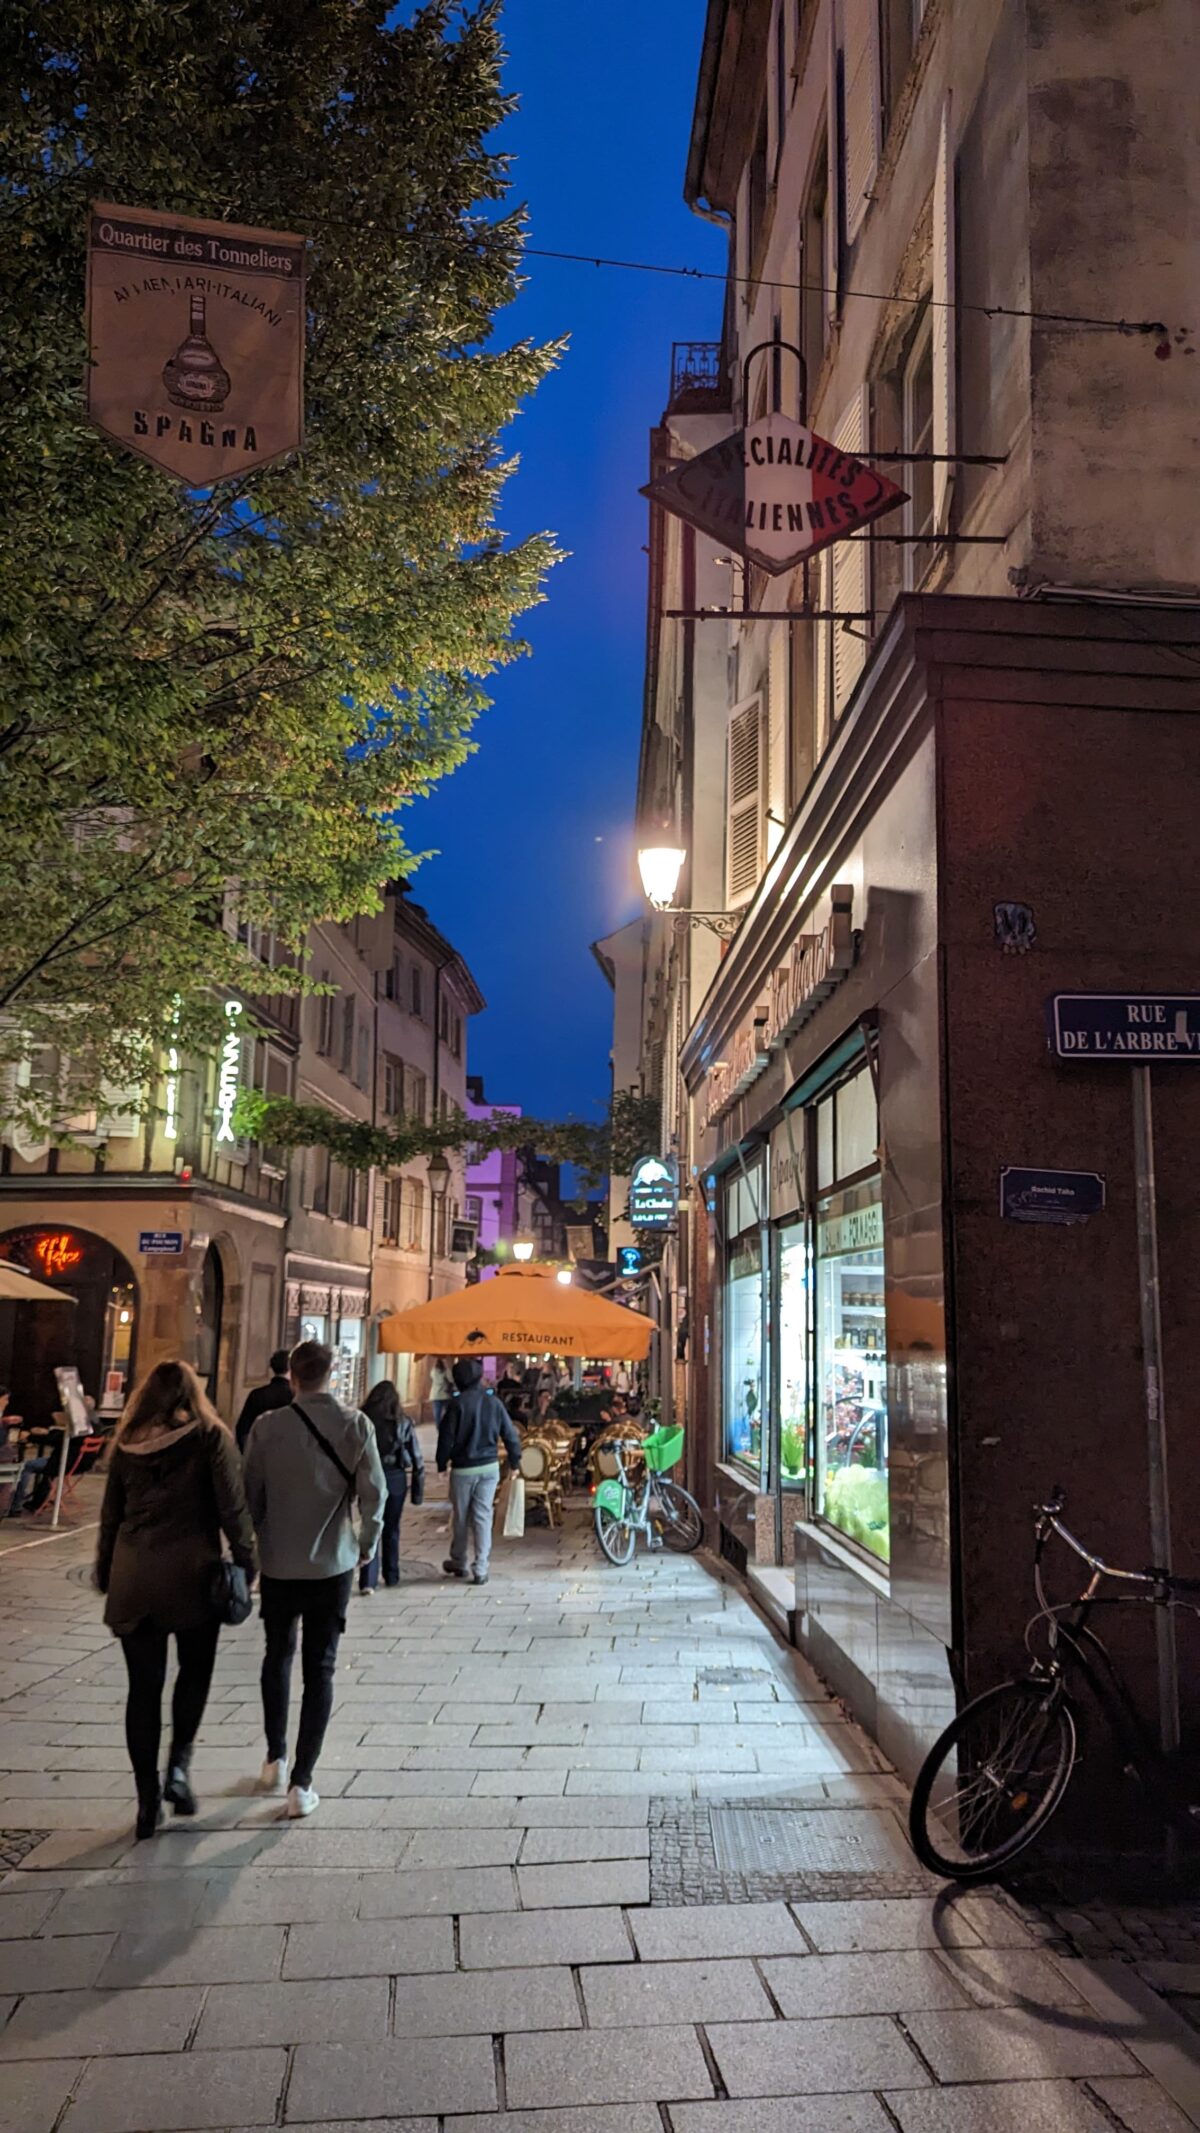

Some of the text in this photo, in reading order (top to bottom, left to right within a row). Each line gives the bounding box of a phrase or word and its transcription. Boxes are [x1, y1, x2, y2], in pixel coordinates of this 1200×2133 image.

[100, 223, 293, 272] Quartier des Tonneliers
[134, 411, 258, 452] SPAGNA
[1127, 1005, 1166, 1023] RUE
[1064, 1031, 1089, 1049] DE
[1095, 1031, 1178, 1050] L'ARBRE
[501, 1332, 574, 1346] RESTAURANT
